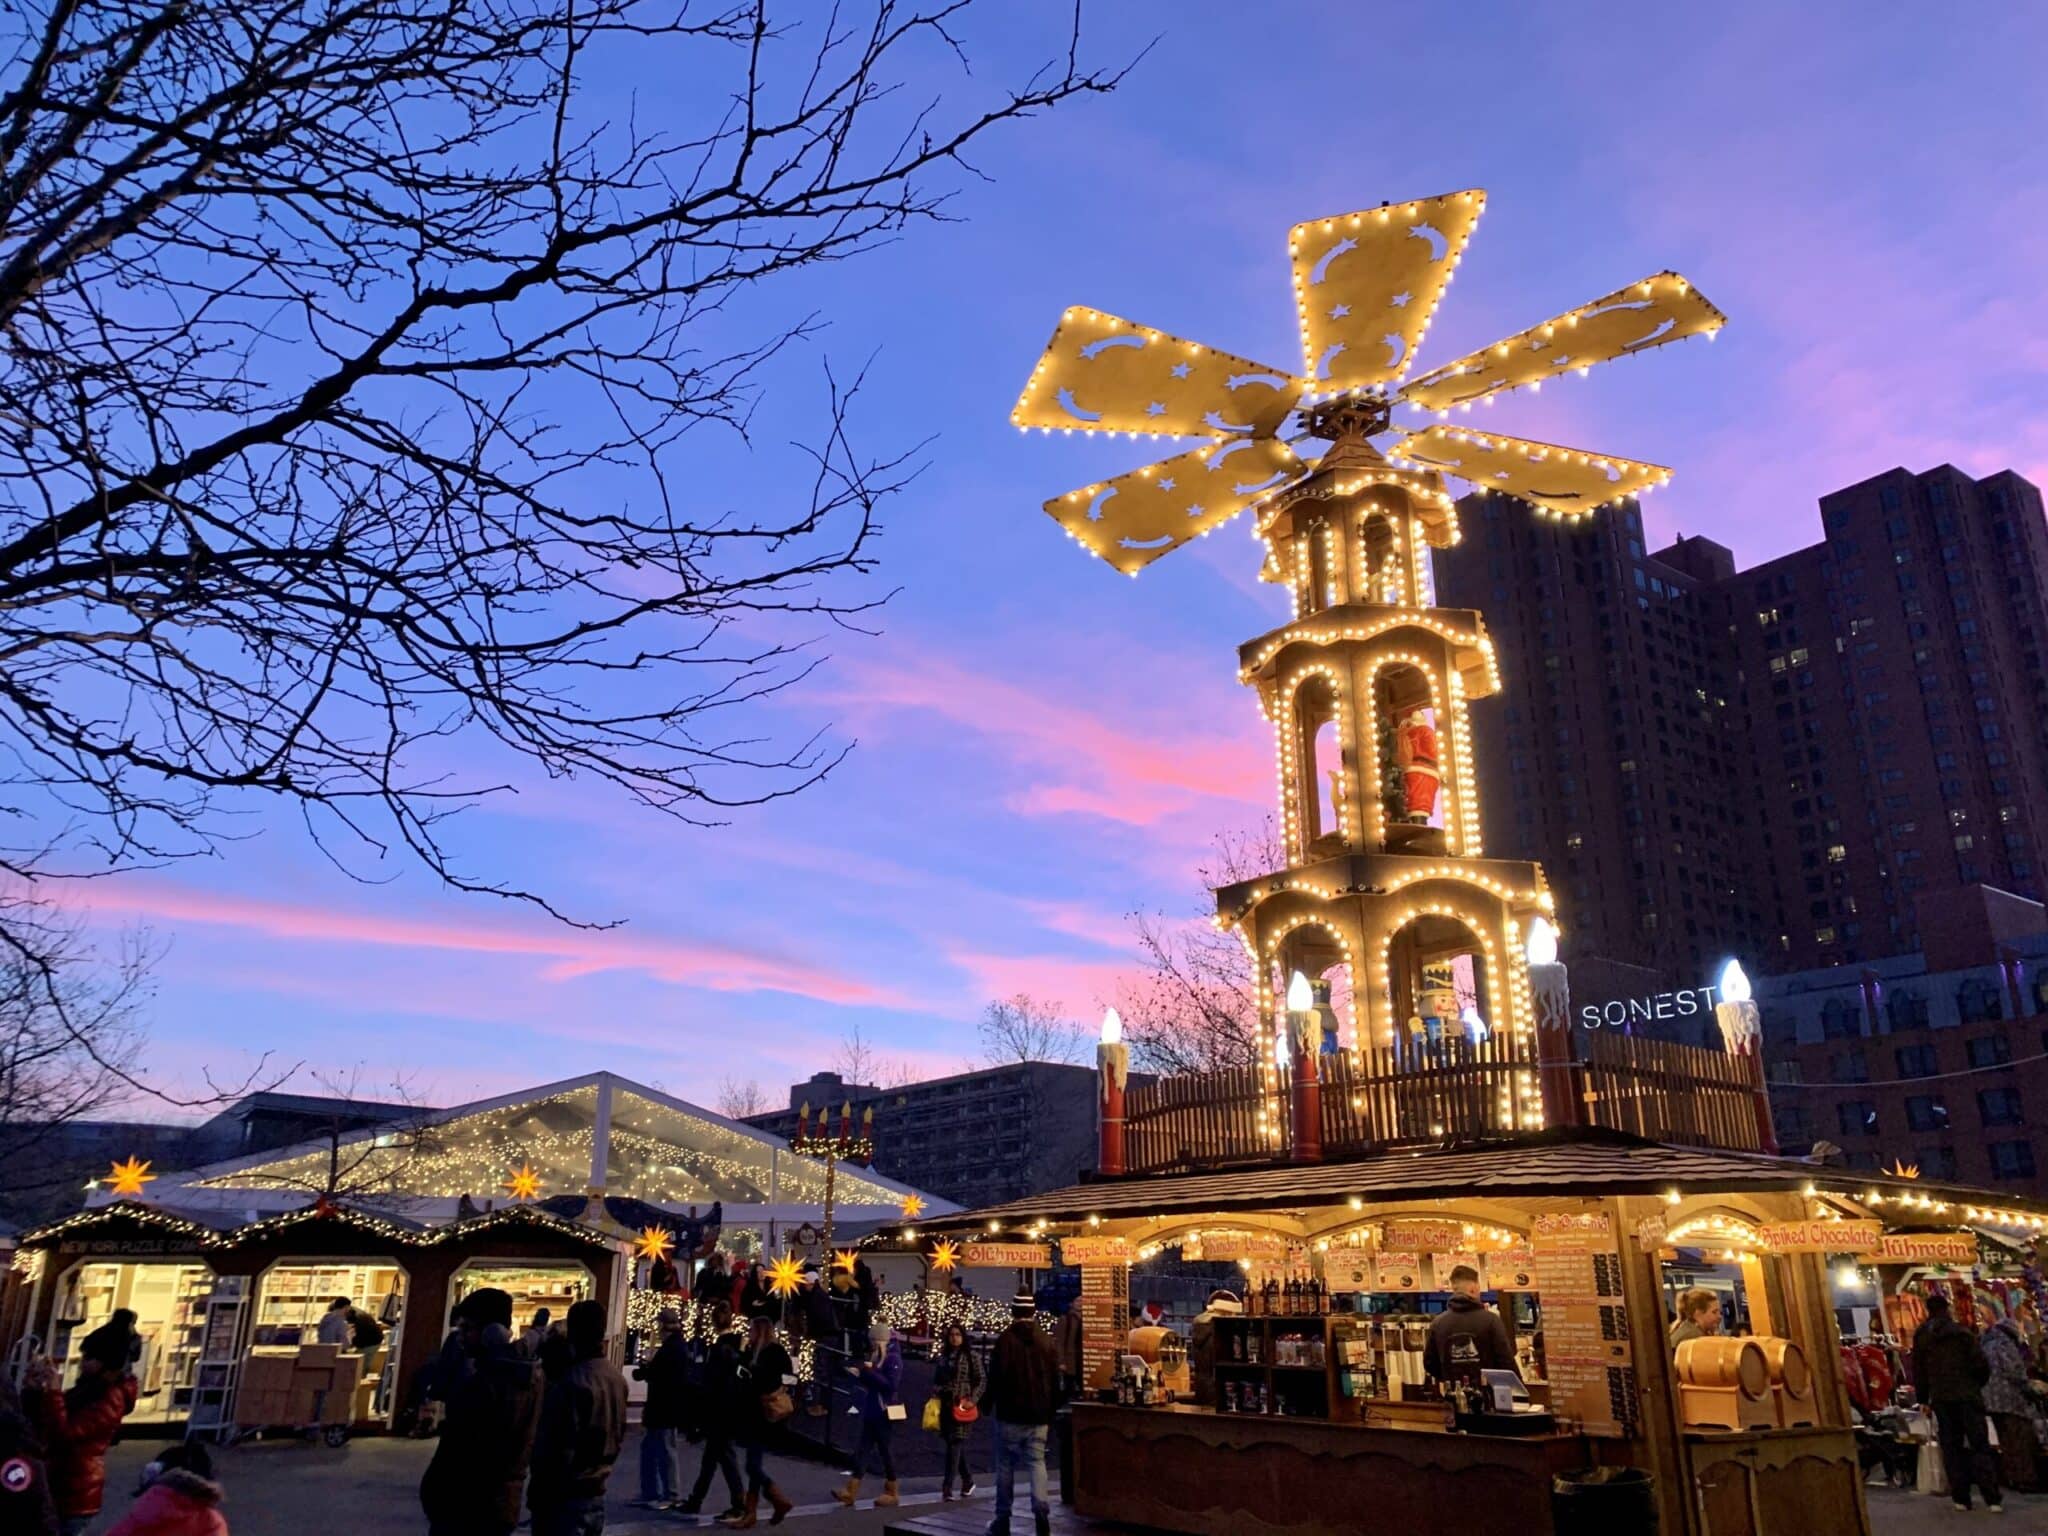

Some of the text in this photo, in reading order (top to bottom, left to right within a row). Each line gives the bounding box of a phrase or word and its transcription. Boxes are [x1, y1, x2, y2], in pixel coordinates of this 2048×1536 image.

[1582, 985, 1717, 1030] SONEST
[1386, 1226, 1464, 1247] Irish Coffee
[1760, 1220, 1877, 1252] Spiked Chocolate
[59, 1240, 88, 1254] NEW
[90, 1240, 119, 1253] YORK
[121, 1240, 165, 1253] PUZZLE
[968, 1246, 1043, 1264] Glühwein
[1067, 1241, 1137, 1259] Apple Cider
